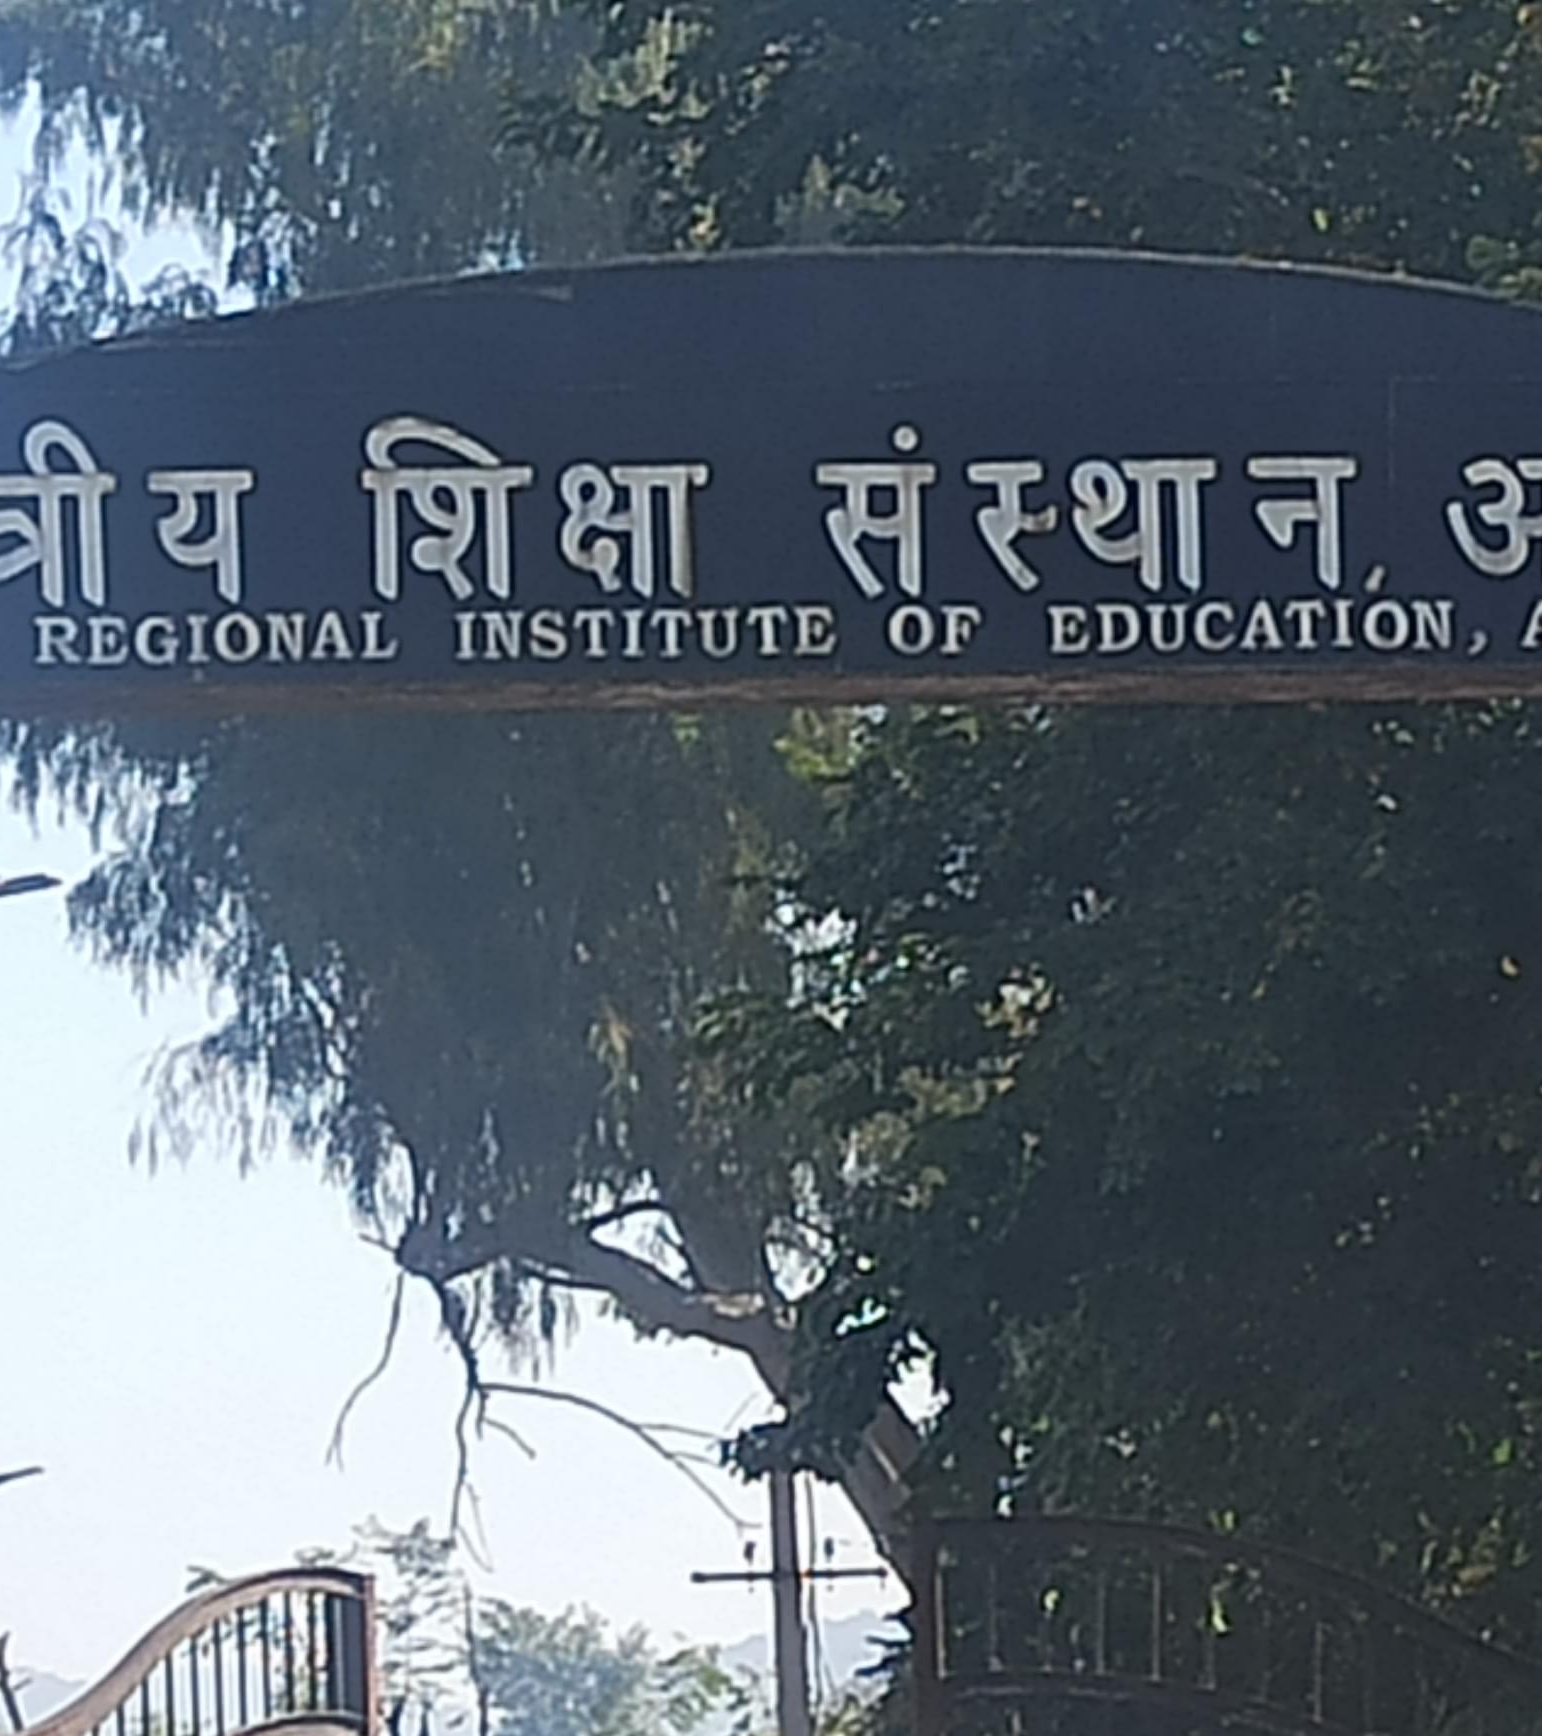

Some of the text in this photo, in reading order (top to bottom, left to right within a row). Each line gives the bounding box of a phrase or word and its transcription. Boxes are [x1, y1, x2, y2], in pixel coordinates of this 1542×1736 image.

[361, 415, 709, 601] शिक्षा
[815, 424, 1356, 598] संस्थान
[34, 612, 400, 666] REGIONAL
[453, 605, 838, 662] INSTITUTE
[888, 605, 982, 654] OF
[1048, 598, 1488, 655] EDUCATION,
